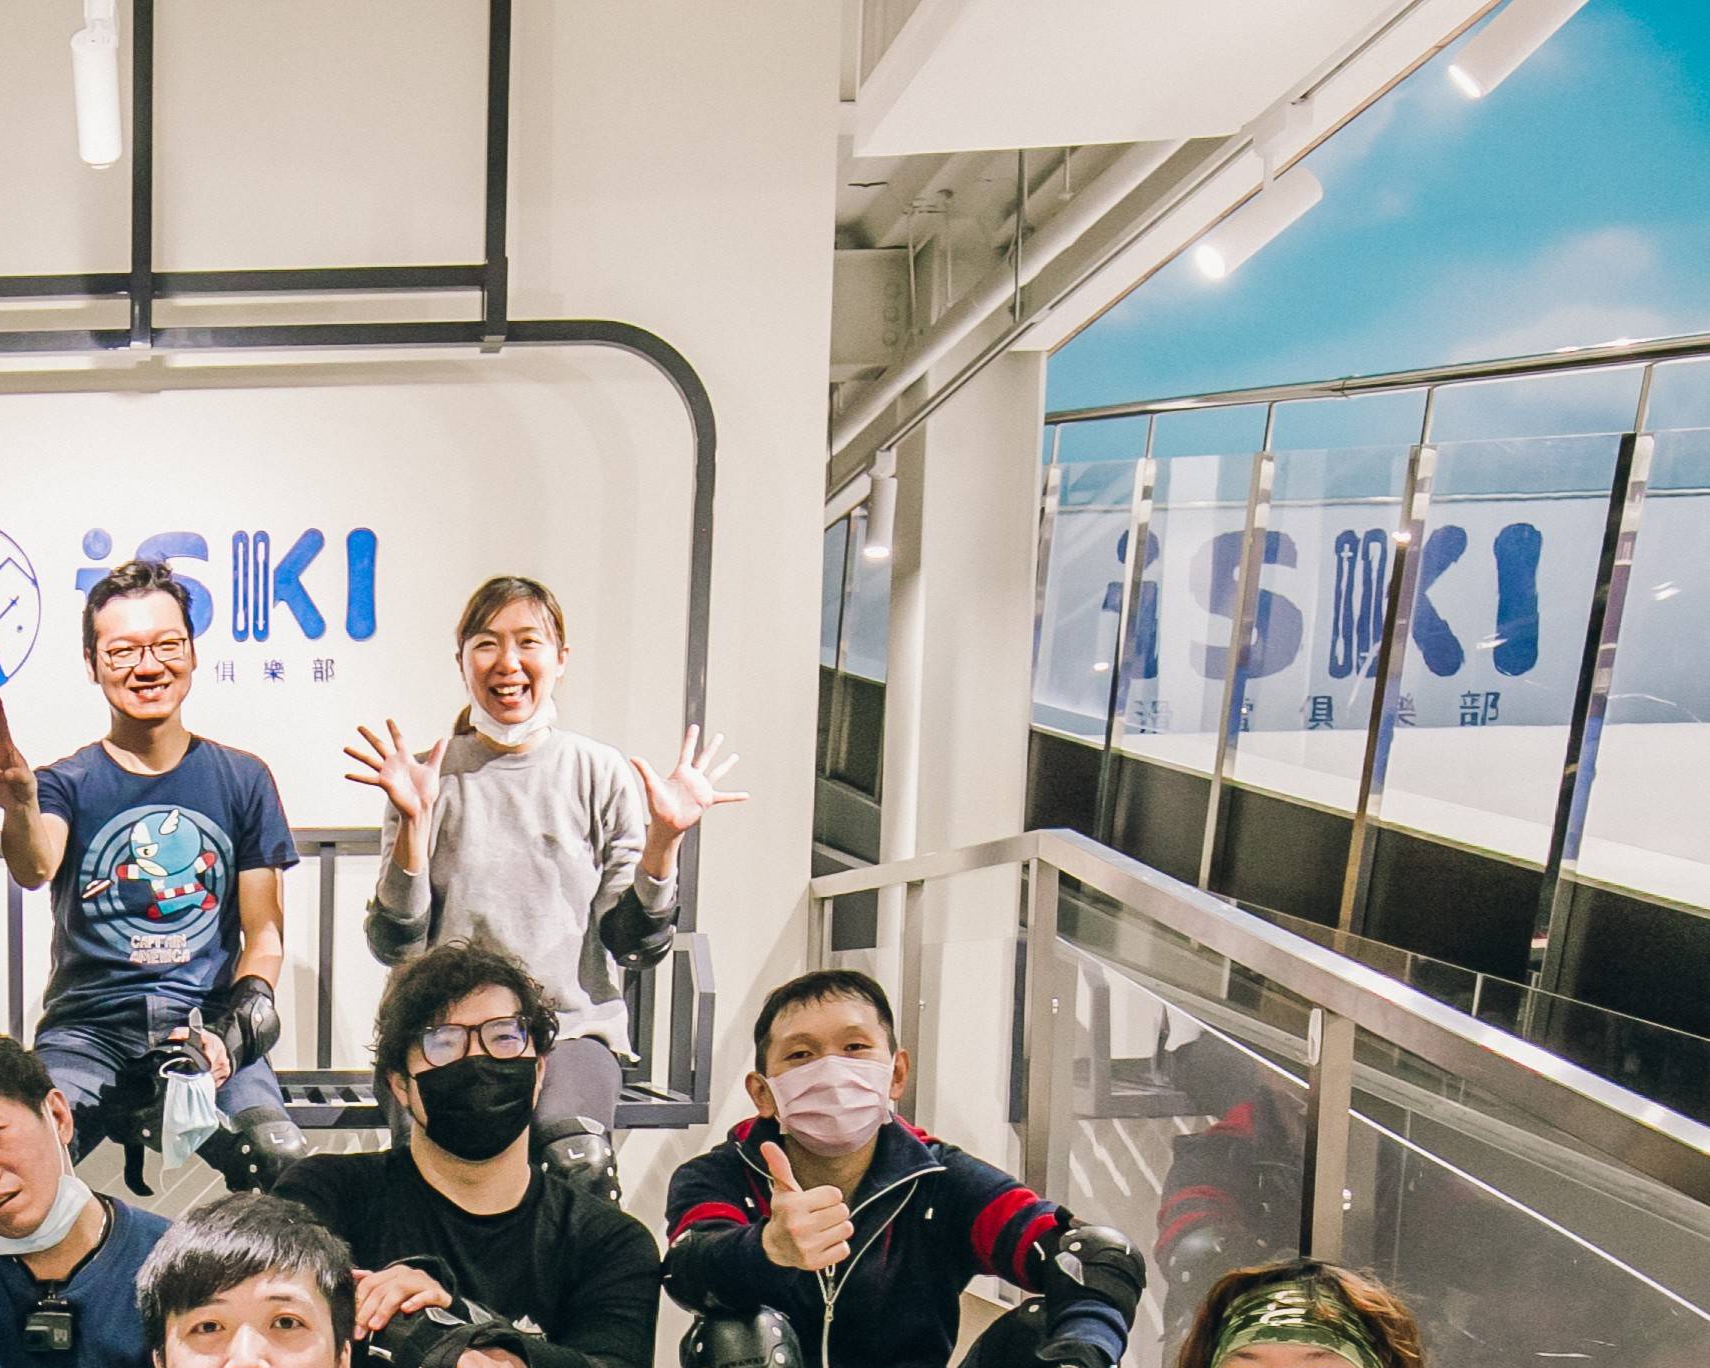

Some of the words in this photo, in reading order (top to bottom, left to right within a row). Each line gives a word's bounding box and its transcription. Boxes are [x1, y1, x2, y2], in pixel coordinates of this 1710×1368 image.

[75, 527, 378, 643] iSKI
[1102, 521, 1543, 680] iSKI
[130, 948, 191, 963] AMERICA
